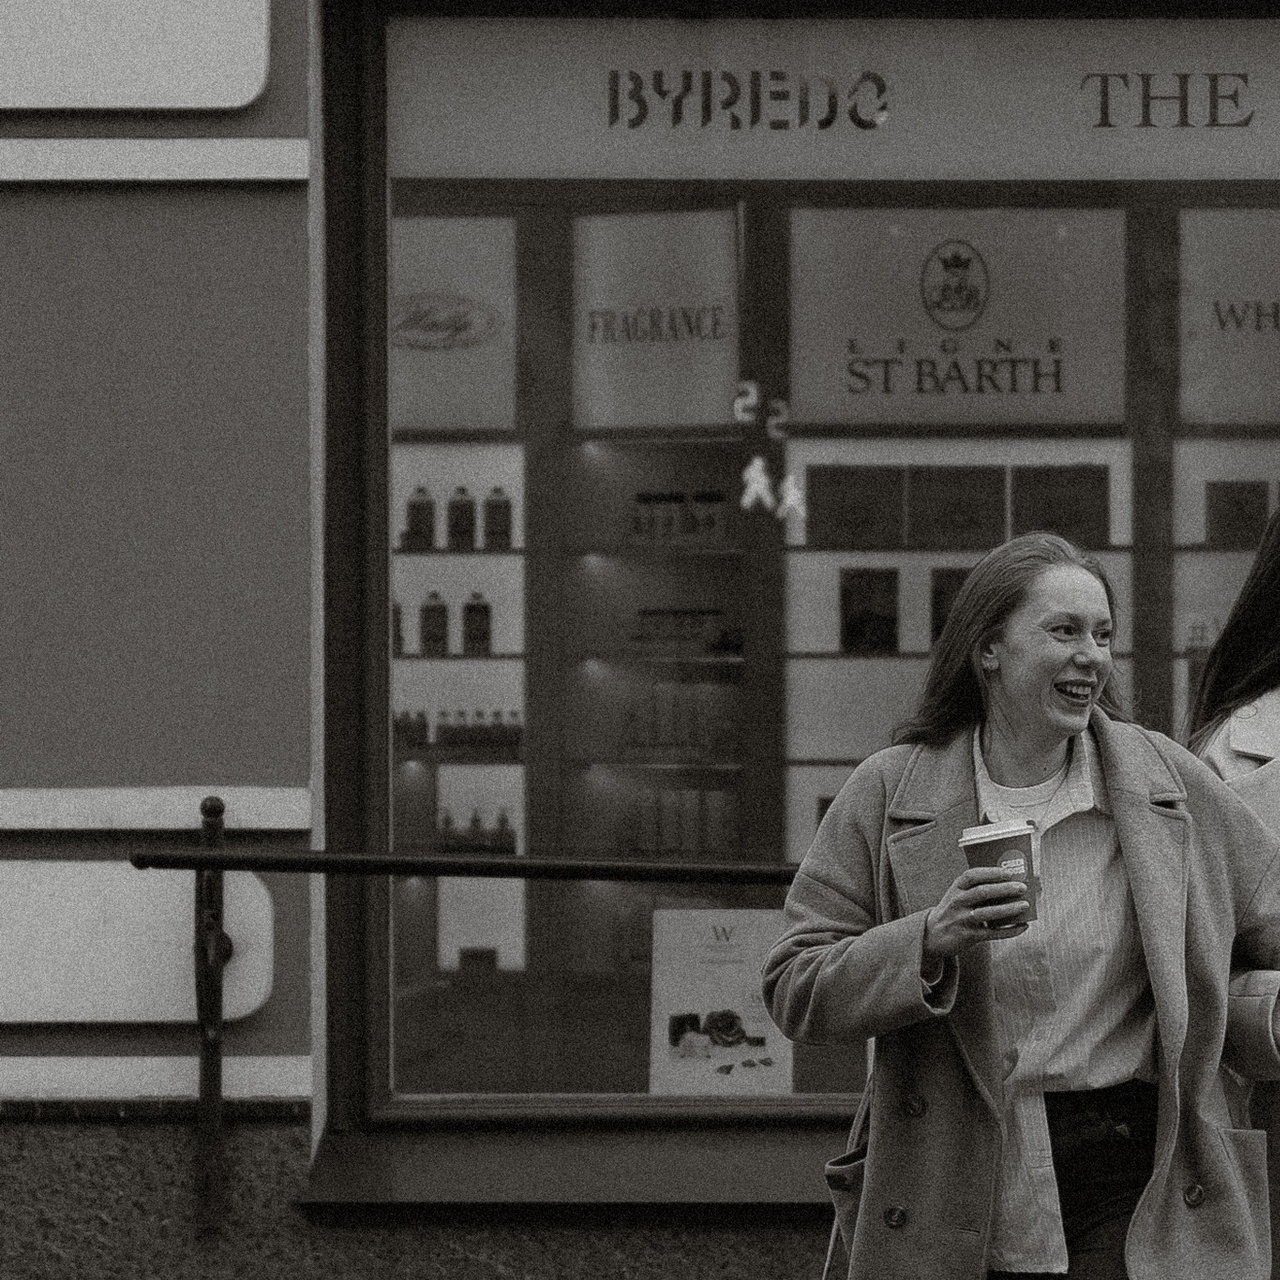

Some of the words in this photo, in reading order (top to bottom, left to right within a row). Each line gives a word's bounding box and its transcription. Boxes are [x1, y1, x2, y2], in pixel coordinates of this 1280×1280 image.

[608, 69, 888, 131] BYREDO
[1080, 71, 1255, 128] THE
[588, 305, 726, 344] FRAGRANCE
[847, 358, 903, 394] ST
[915, 358, 1063, 394] BARTH
